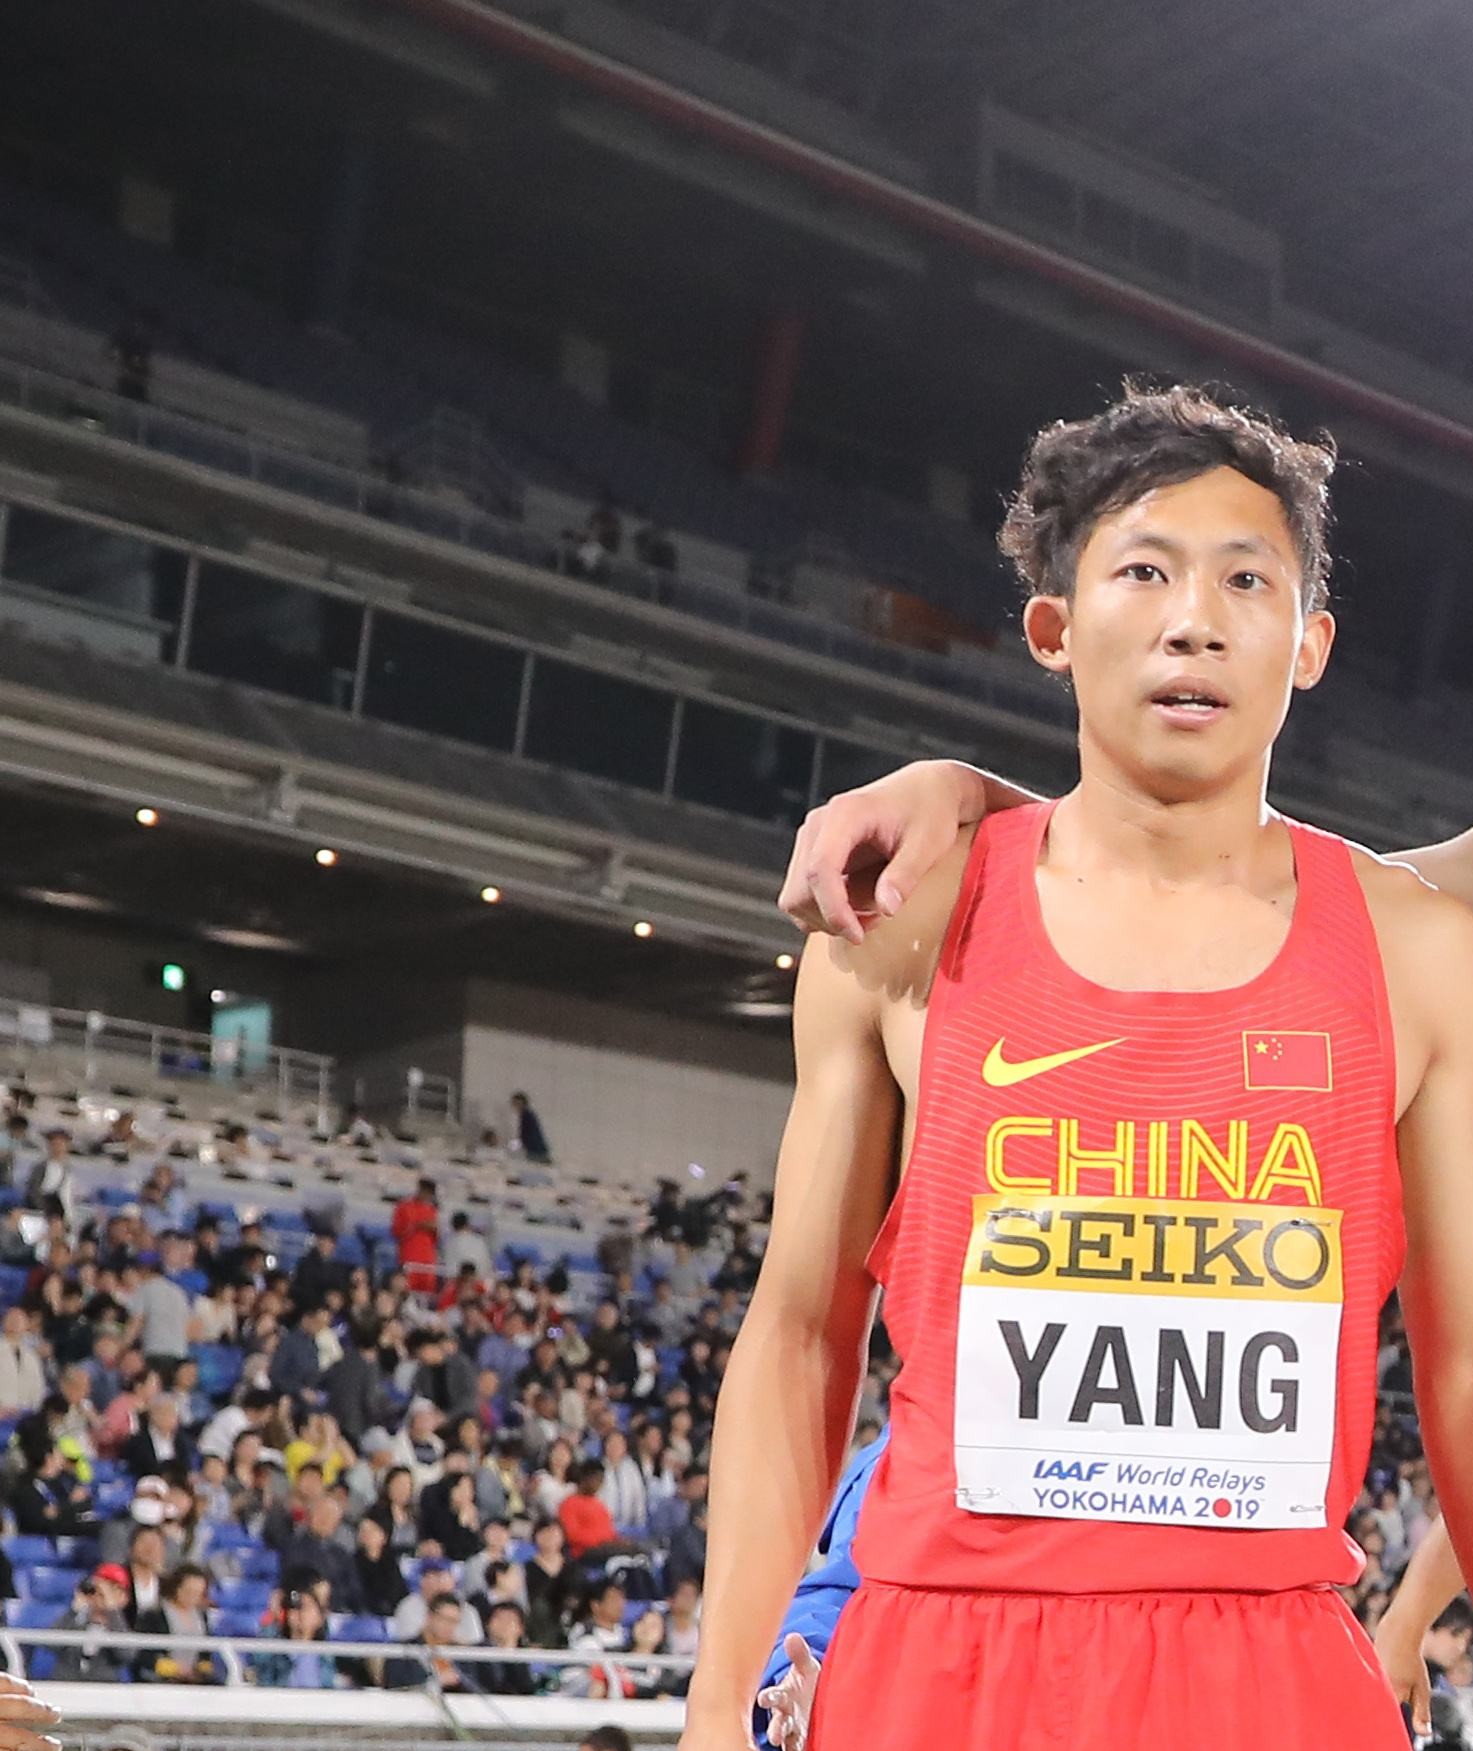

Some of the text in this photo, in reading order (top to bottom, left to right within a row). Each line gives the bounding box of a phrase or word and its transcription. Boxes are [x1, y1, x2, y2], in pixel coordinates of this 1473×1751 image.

[985, 1115, 1321, 1206] CHINA
[979, 1208, 1329, 1291] SEIKO
[997, 1319, 1300, 1434] YANG
[1032, 1458, 1266, 1492] IAAF World Relays
[1033, 1488, 1187, 1516] YOKOHAMA
